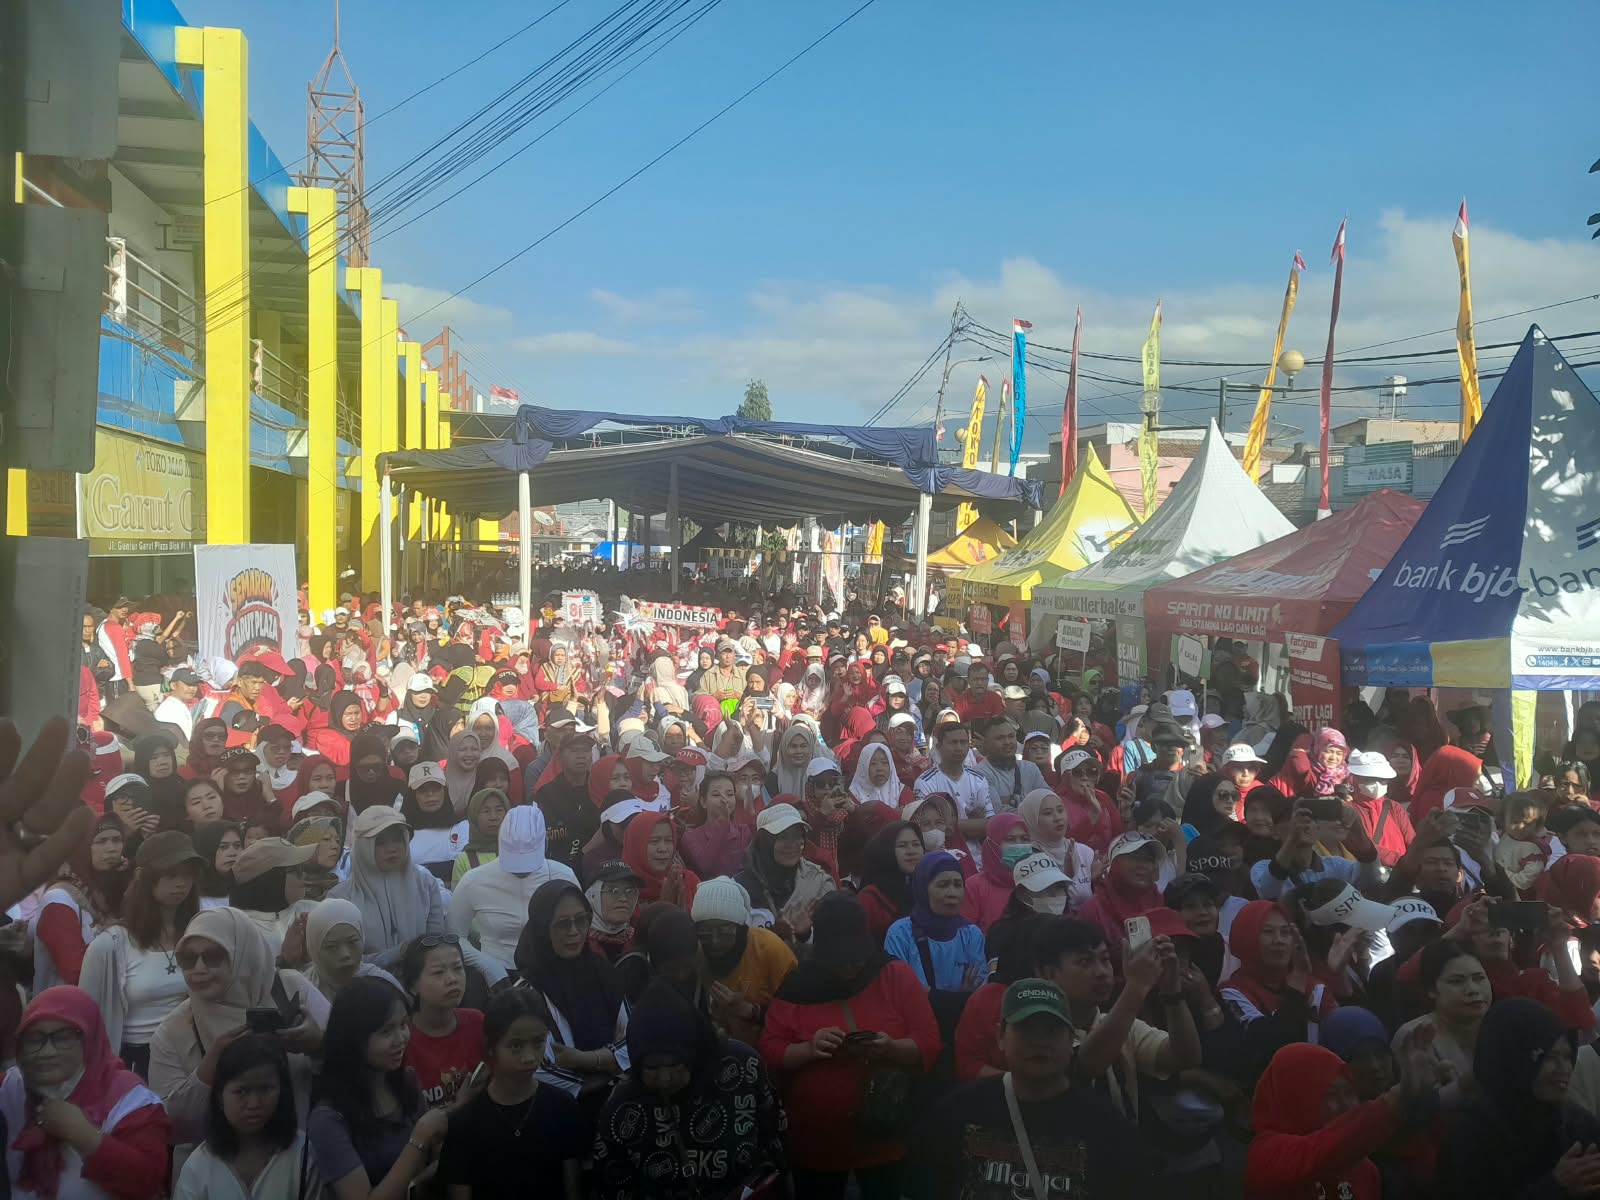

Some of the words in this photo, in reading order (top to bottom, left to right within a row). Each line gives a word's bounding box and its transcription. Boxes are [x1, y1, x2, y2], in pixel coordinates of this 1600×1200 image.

[969, 406, 981, 466] TOKO
[145, 450, 167, 474] TOKO
[92, 474, 173, 533] Garut
[1393, 559, 1458, 591] bank
[1459, 562, 1519, 603] bjb
[231, 568, 273, 616] SEMARAK
[653, 608, 718, 623] INDONESIA
[1081, 597, 1119, 615] Herbal
[1167, 601, 1213, 618] SPIRIT
[1214, 604, 1232, 619] NO
[1234, 606, 1271, 623] LIMIT
[231, 612, 254, 657] GARUT
[254, 611, 278, 642] PLAZA
[1251, 625, 1266, 636] LAGI
[1290, 635, 1318, 650] fatigon
[1315, 704, 1333, 720] LAGI
[422, 766, 432, 777] R
[1017, 989, 1060, 1001] CENDANA
